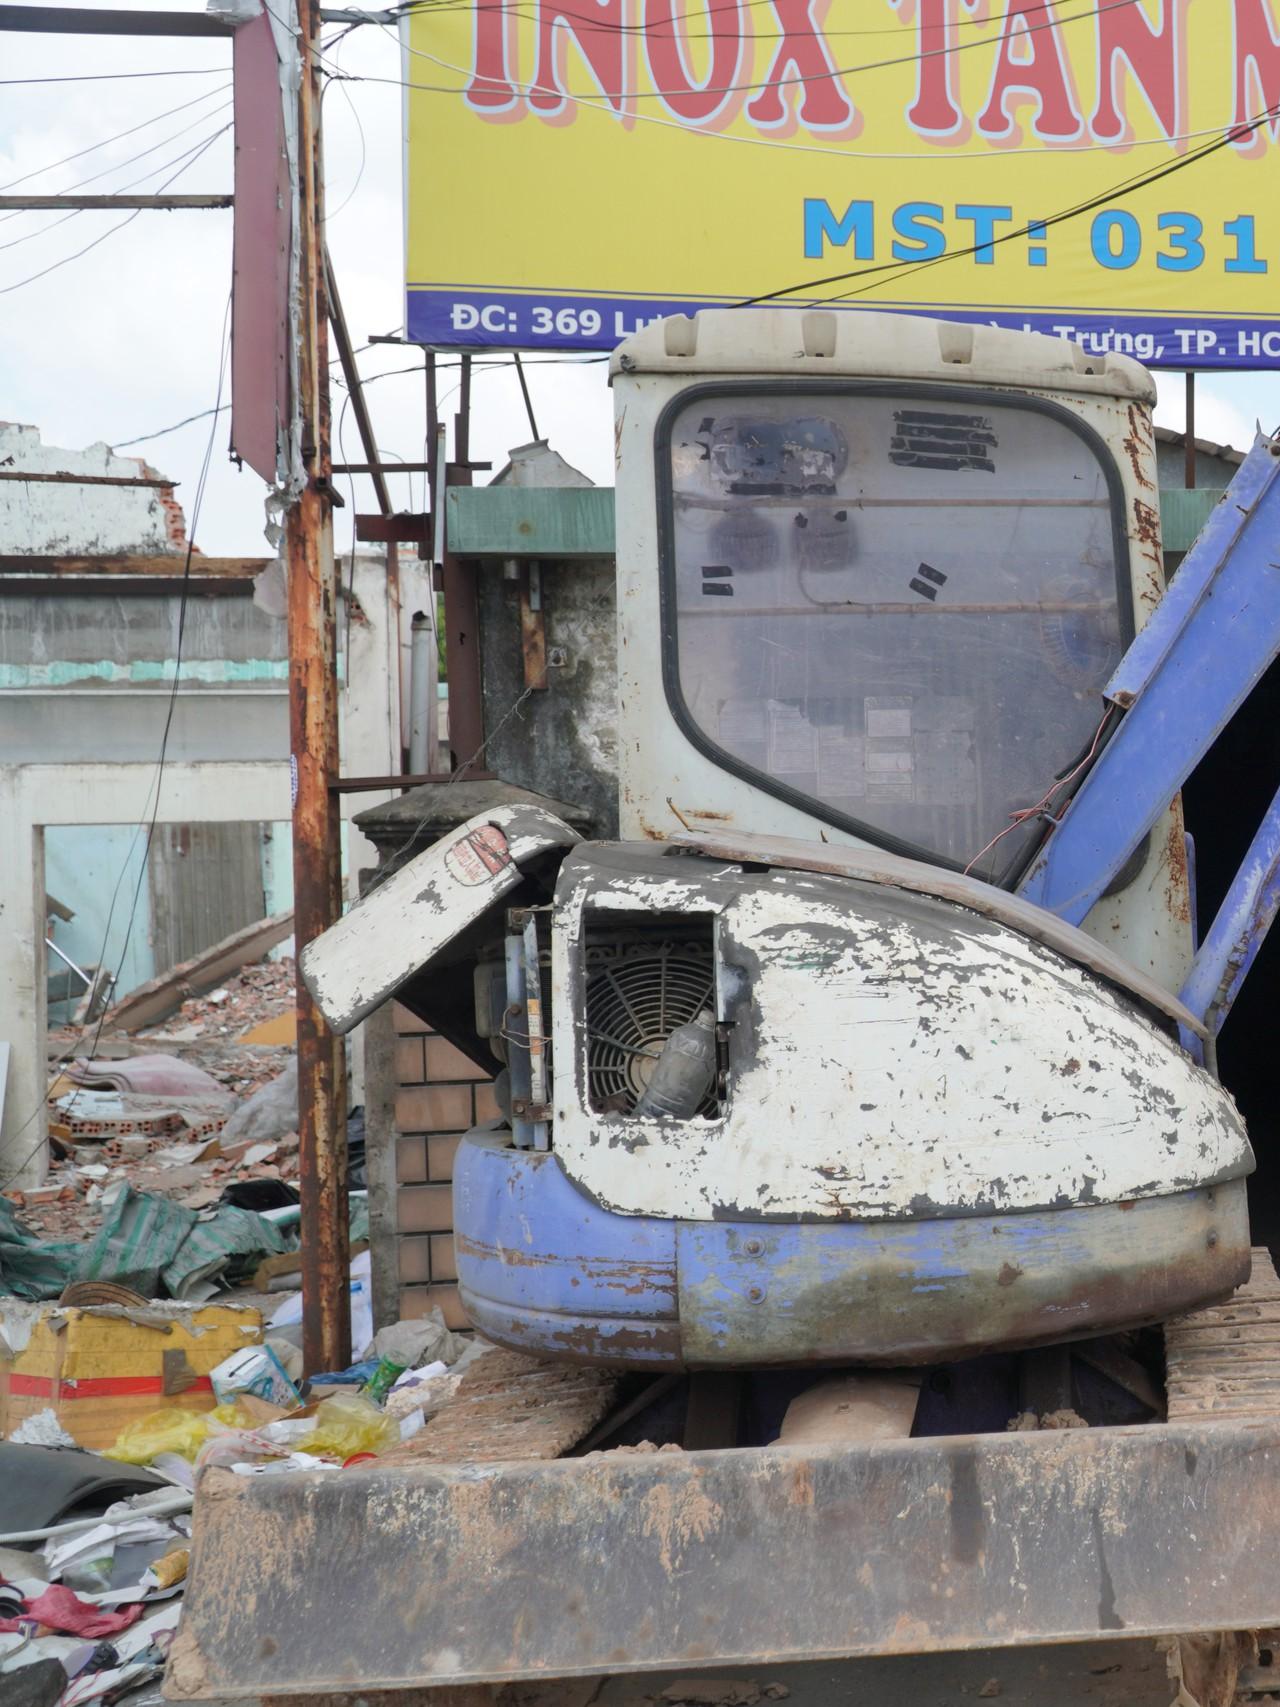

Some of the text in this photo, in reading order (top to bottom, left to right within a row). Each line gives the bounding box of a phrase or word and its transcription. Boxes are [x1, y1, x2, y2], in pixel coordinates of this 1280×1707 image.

[465, 0, 860, 136] INOX
[803, 198, 1048, 267] MST:
[451, 303, 517, 333] ĐC:
[531, 307, 601, 336] 369
[1174, 328, 1226, 356] TP.
